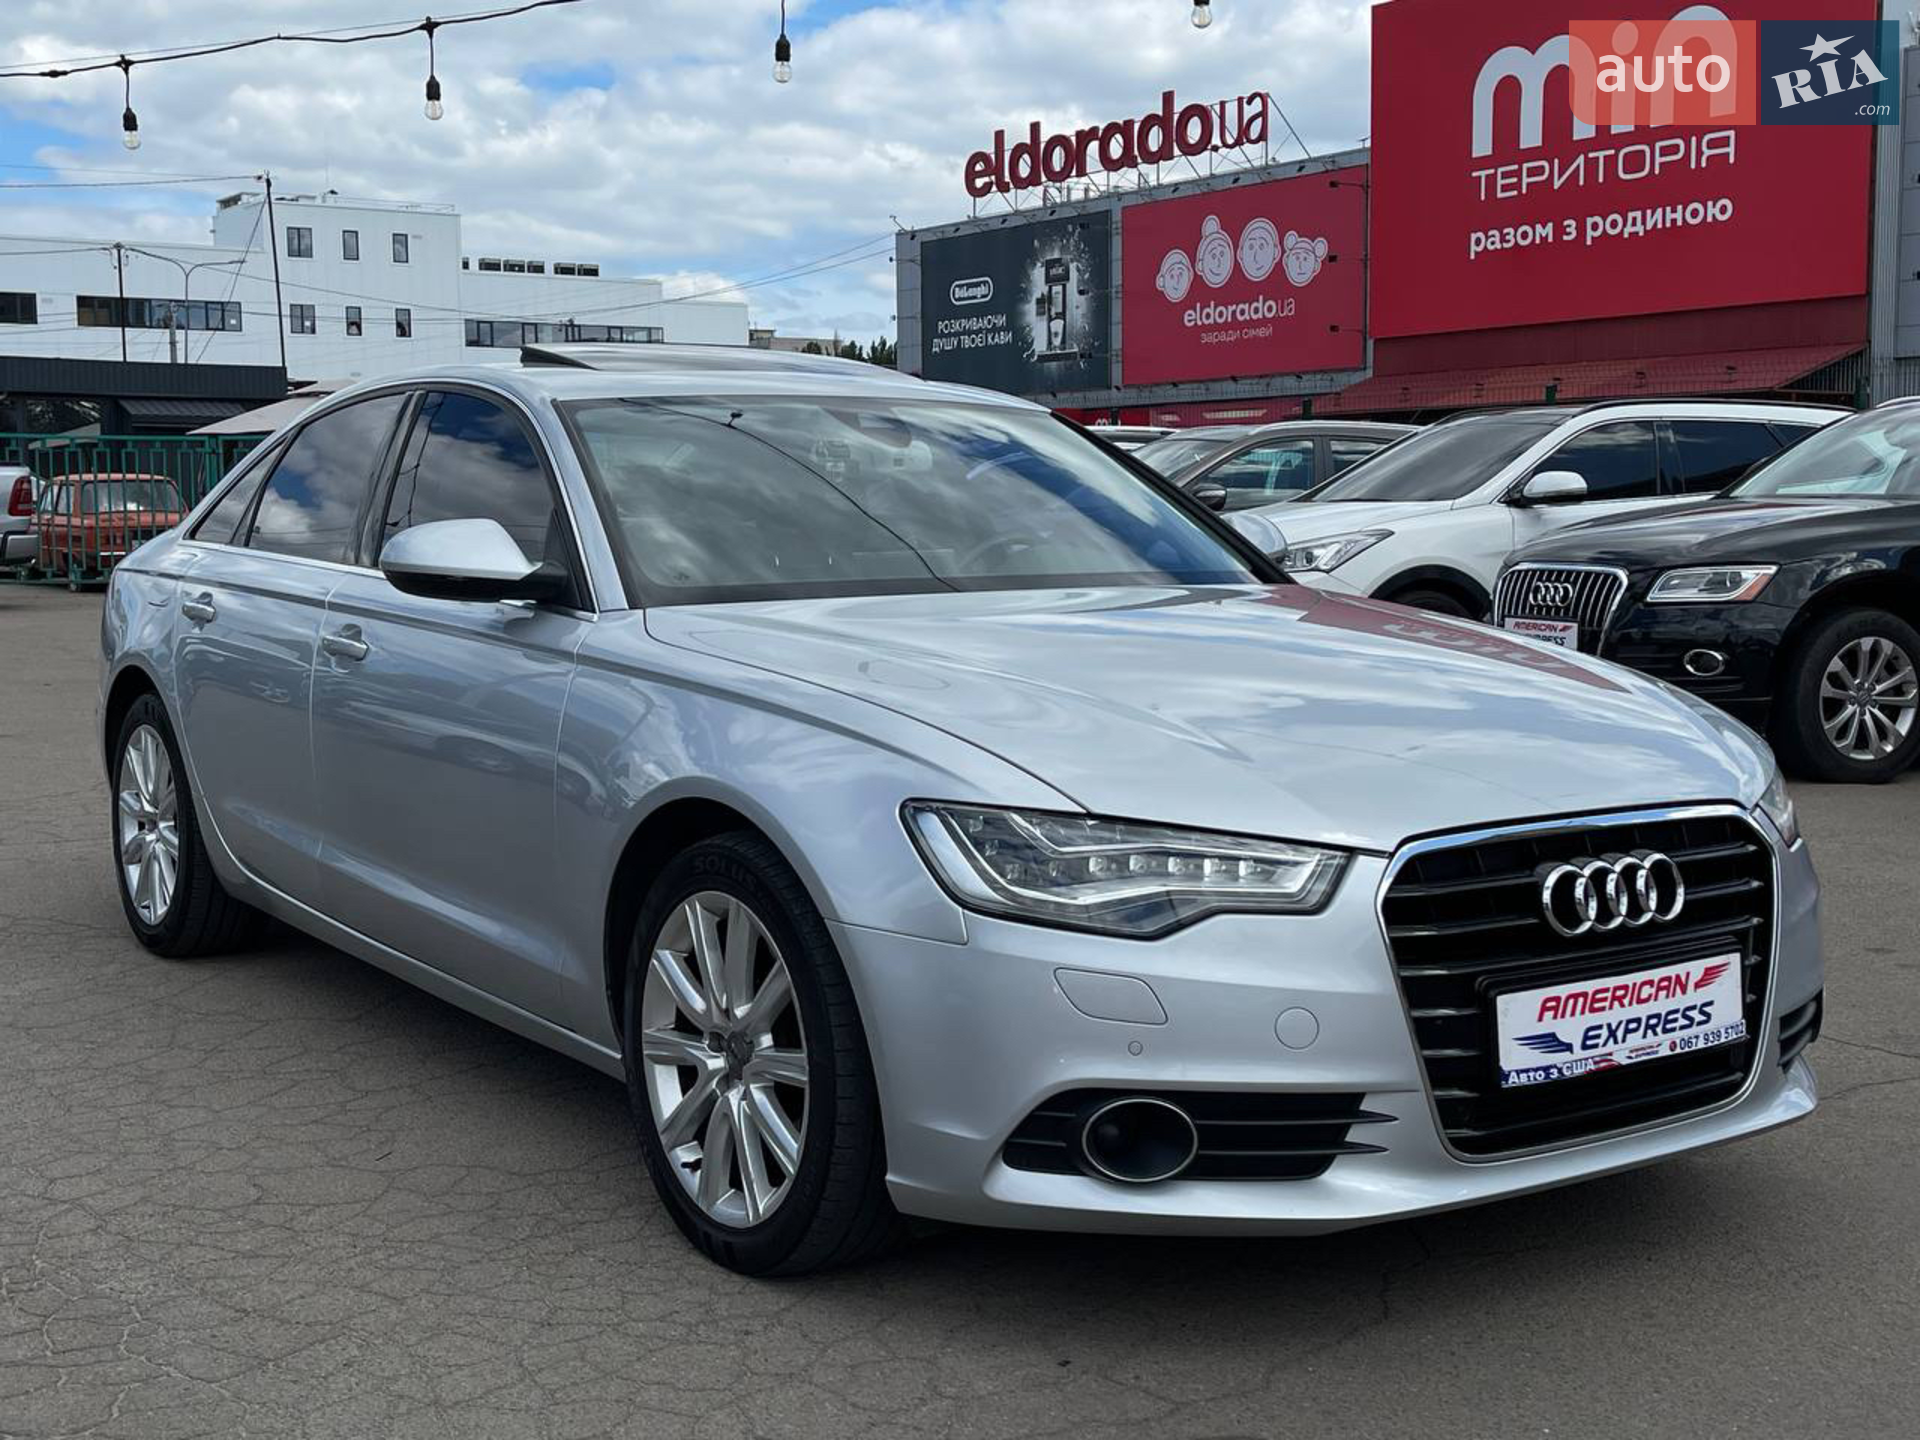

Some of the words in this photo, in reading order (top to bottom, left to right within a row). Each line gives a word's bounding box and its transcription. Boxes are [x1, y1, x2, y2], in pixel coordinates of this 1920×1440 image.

[964, 90, 1268, 198] eldorado.ua
[1471, 129, 1737, 201] ТЕРИТОРІЯ
[1469, 218, 1554, 261] разом
[1562, 218, 1577, 242] з
[1585, 197, 1734, 246] родиною
[938, 314, 1006, 334] РОЗКРИВАЮЧИ
[1184, 295, 1295, 327] eldorado.ua
[932, 336, 958, 353] ДУШУ
[960, 331, 986, 348] ТВОЄЇ
[988, 332, 1012, 345] КАВИ
[1200, 330, 1241, 344] заради
[1242, 323, 1273, 339] сімей
[1513, 621, 1558, 632] AMERICAN
[1537, 971, 1691, 1022] AMERICAN
[1580, 1000, 1715, 1051] EXPRESS
[1678, 1037, 1701, 1051] 067
[1702, 1030, 1723, 1047] 939
[1507, 1069, 1546, 1085] Авто
[1548, 1068, 1560, 1079] з
[1562, 1058, 1596, 1077] США
